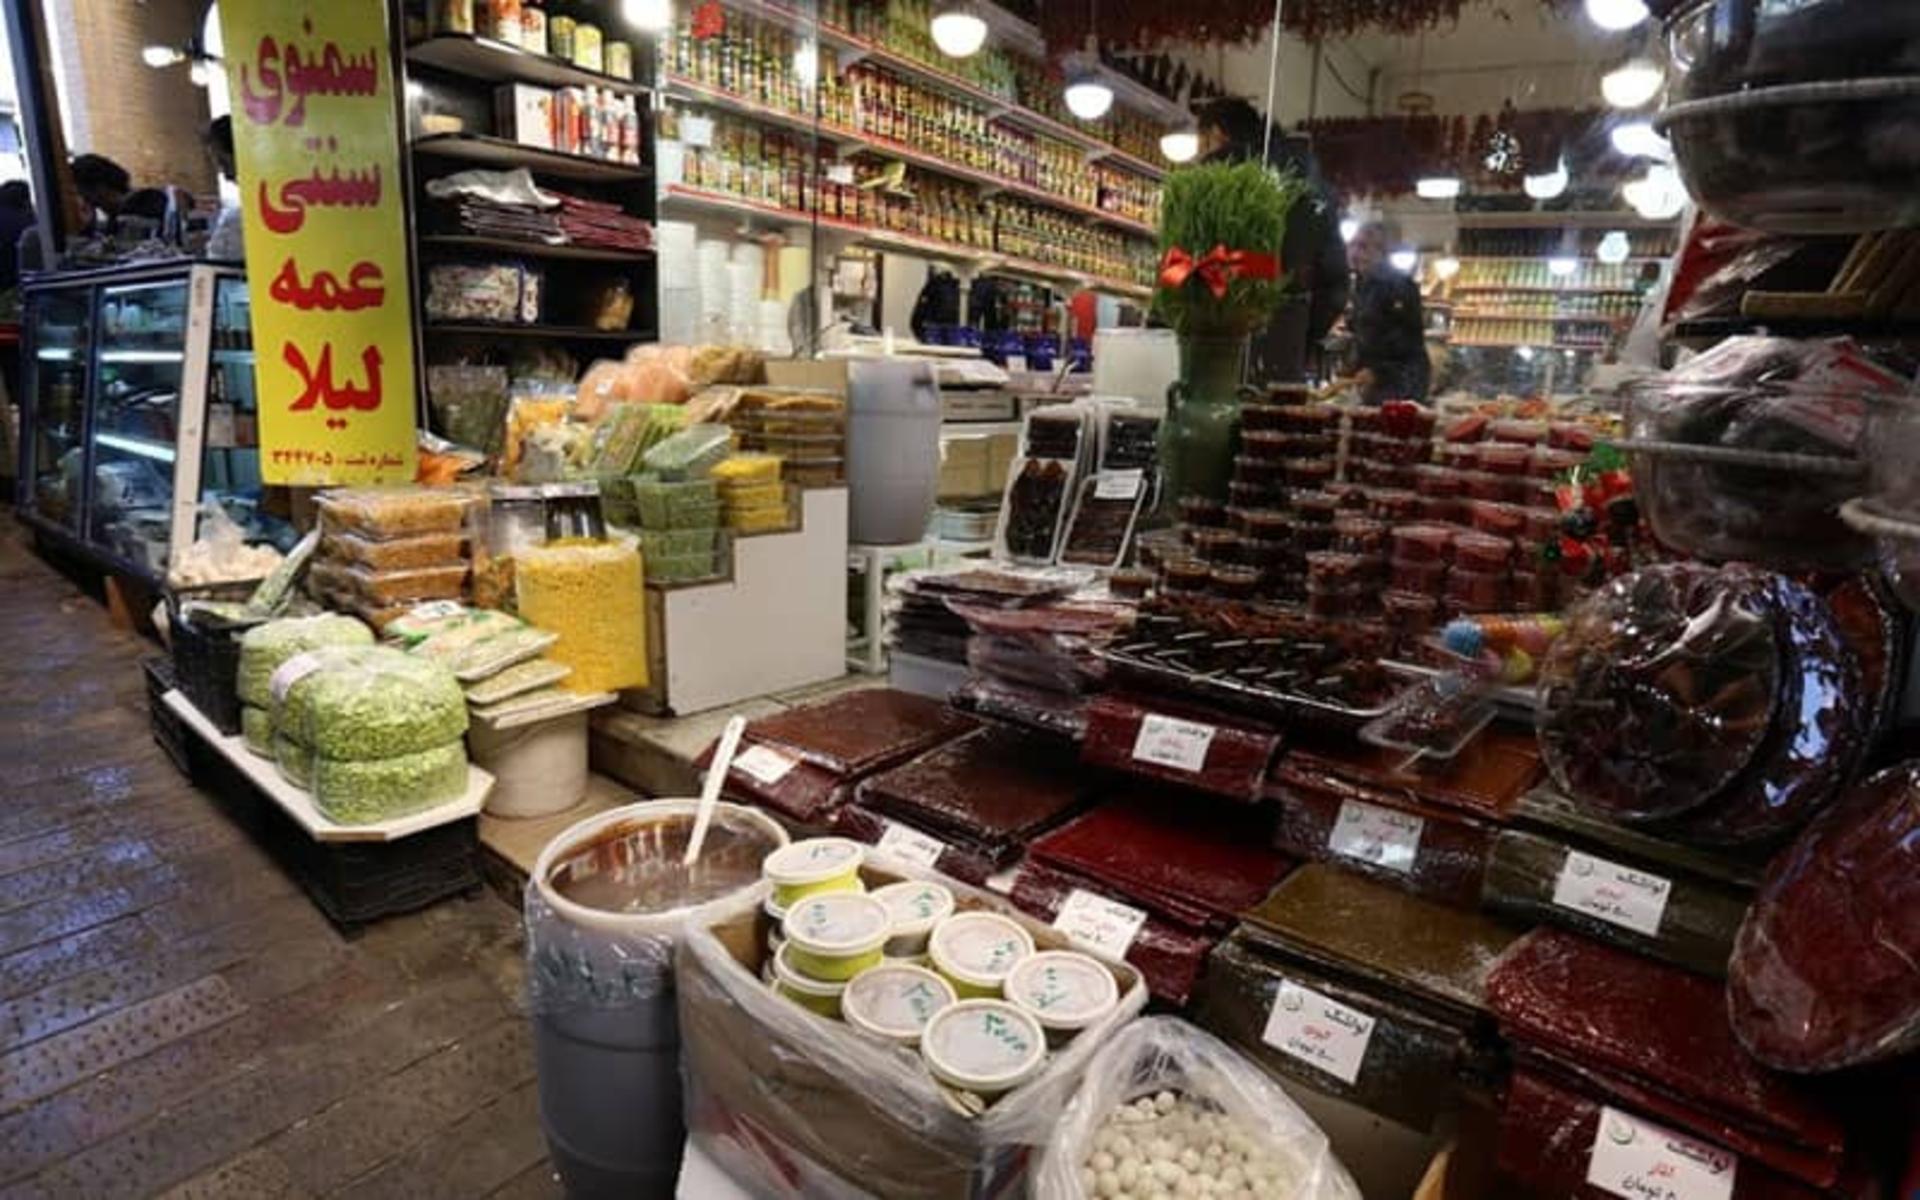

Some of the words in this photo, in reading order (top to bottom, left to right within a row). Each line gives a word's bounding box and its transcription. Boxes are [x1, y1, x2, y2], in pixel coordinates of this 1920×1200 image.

[240, 16, 379, 127] سمنوی
[258, 135, 382, 234] سنتی
[268, 255, 386, 312] عمه
[283, 340, 385, 430] لیلا
